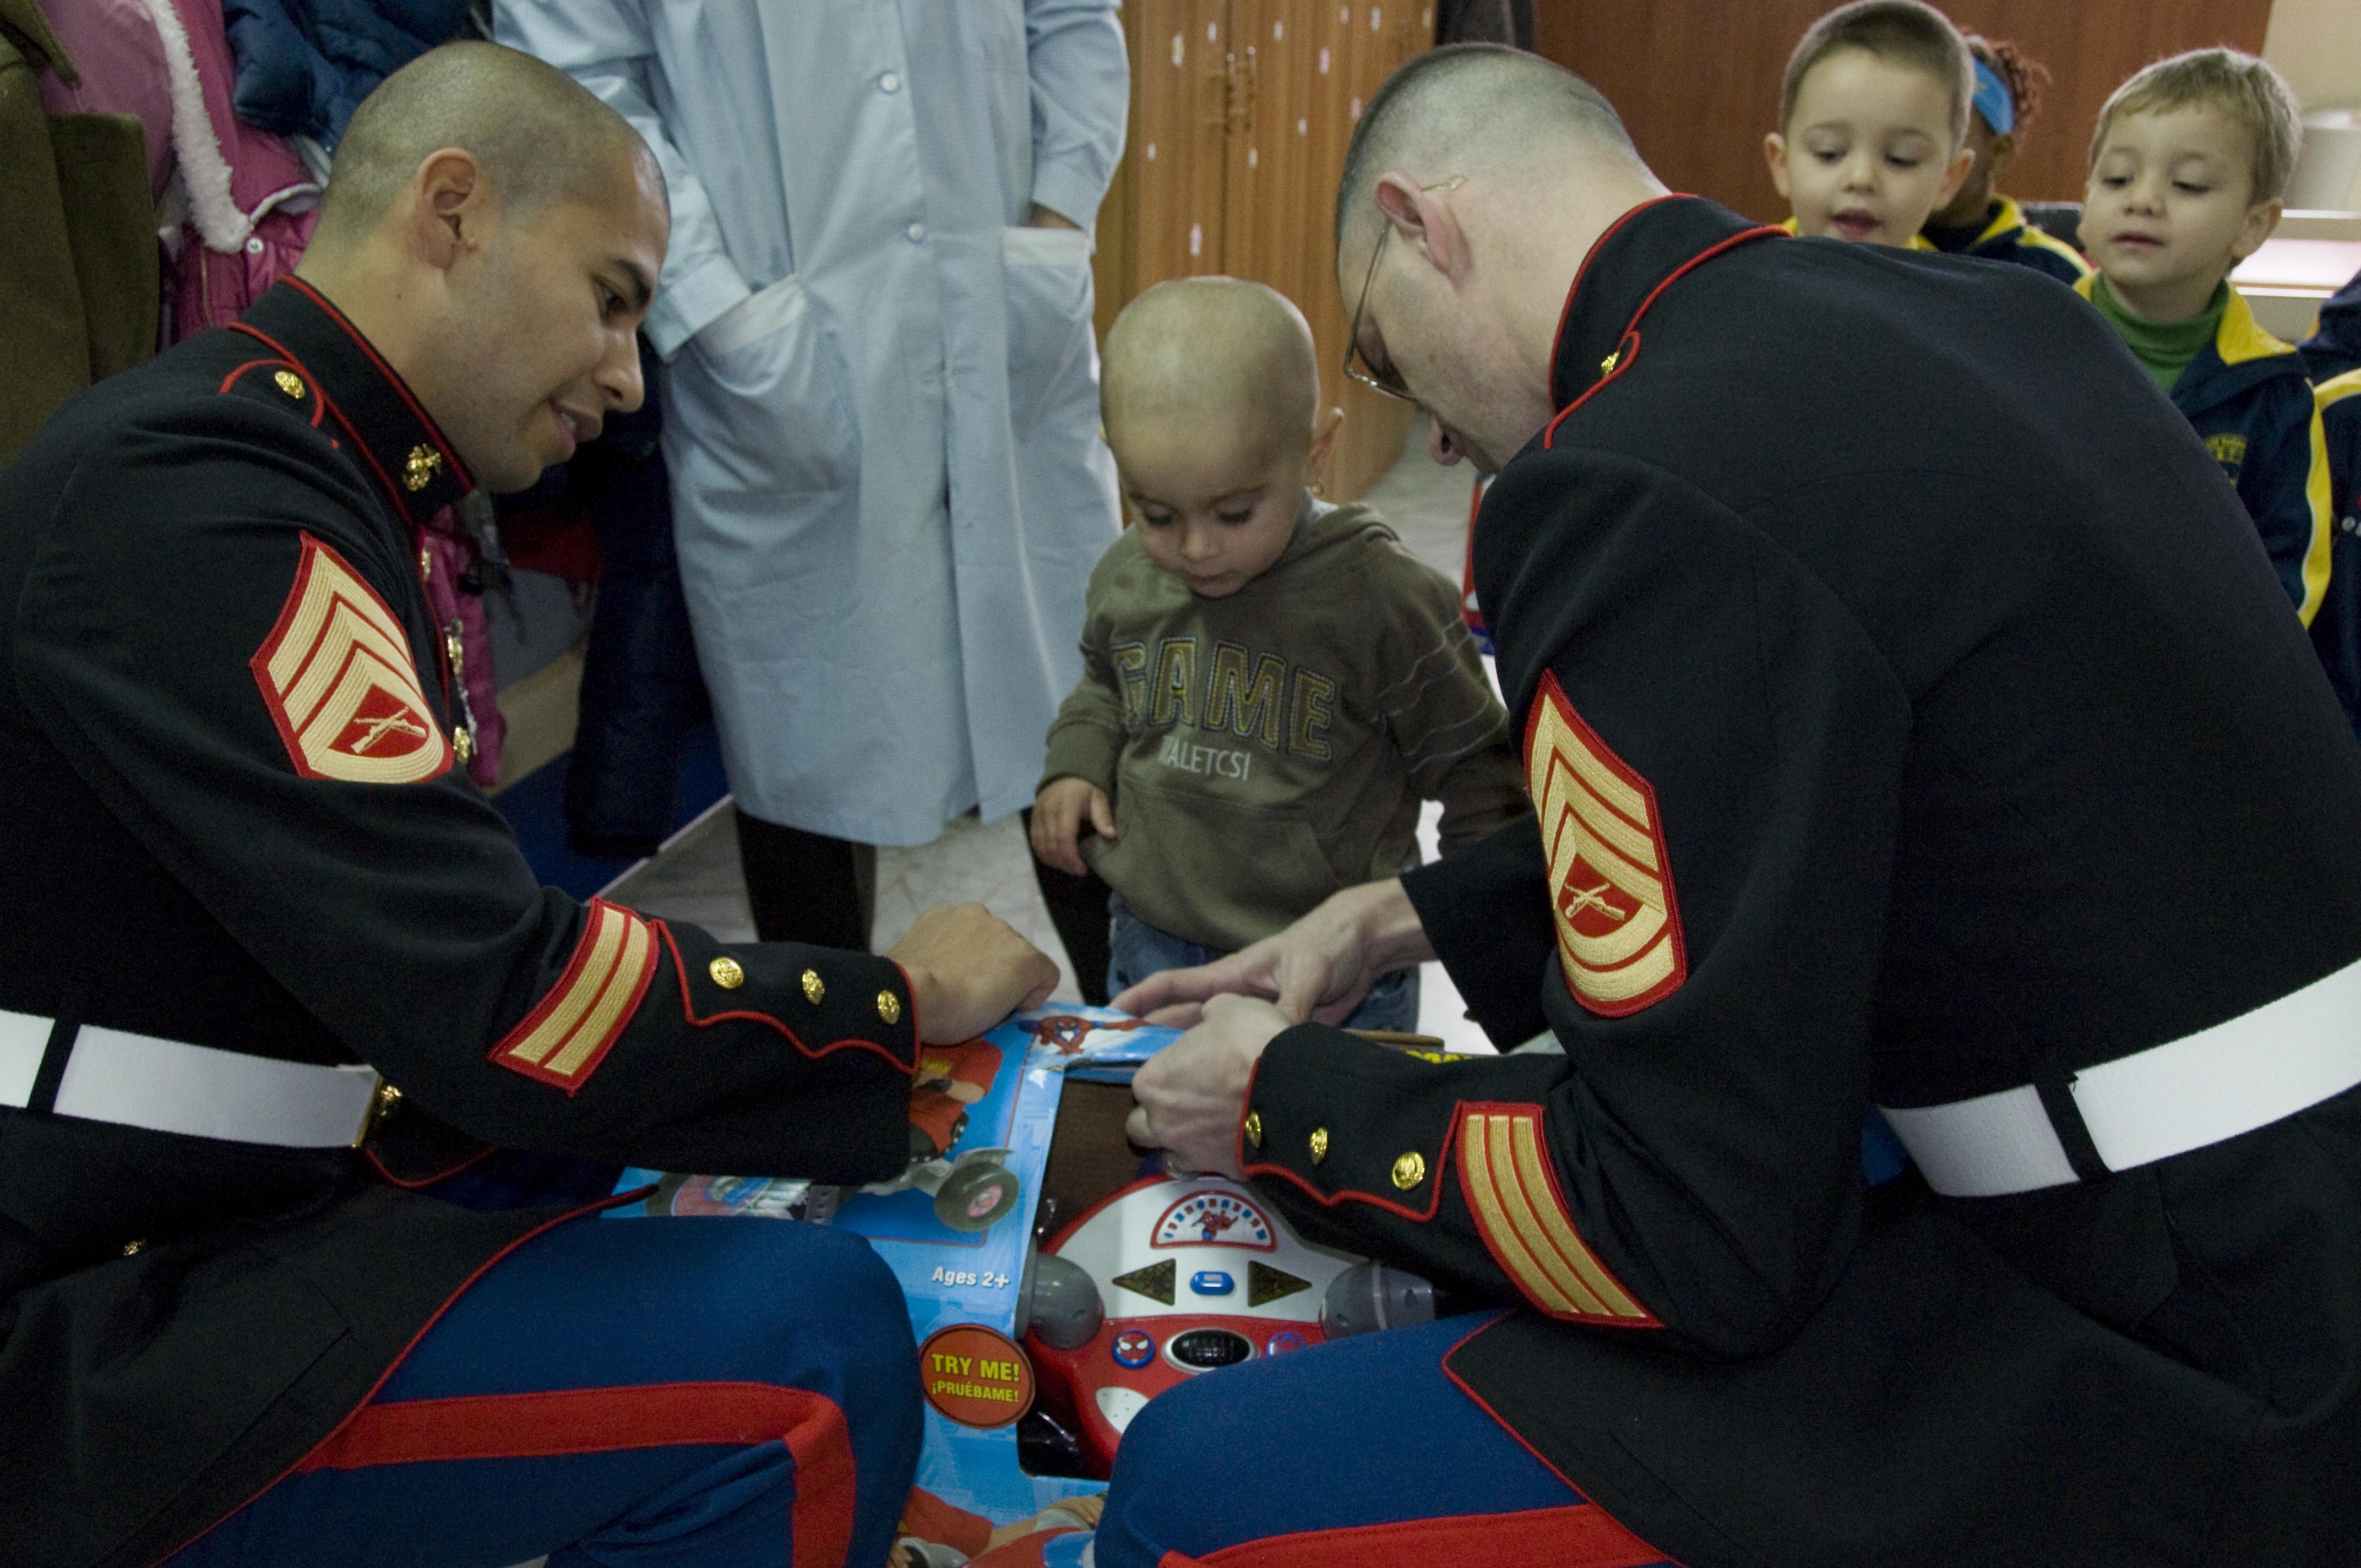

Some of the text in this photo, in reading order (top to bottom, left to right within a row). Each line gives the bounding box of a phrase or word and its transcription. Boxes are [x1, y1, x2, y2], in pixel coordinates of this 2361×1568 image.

[931, 1266, 1010, 1288] Ages 2+
[932, 1354, 1020, 1381] TRY ME!
[932, 1380, 1019, 1403] ¡PRUÉBAME!
